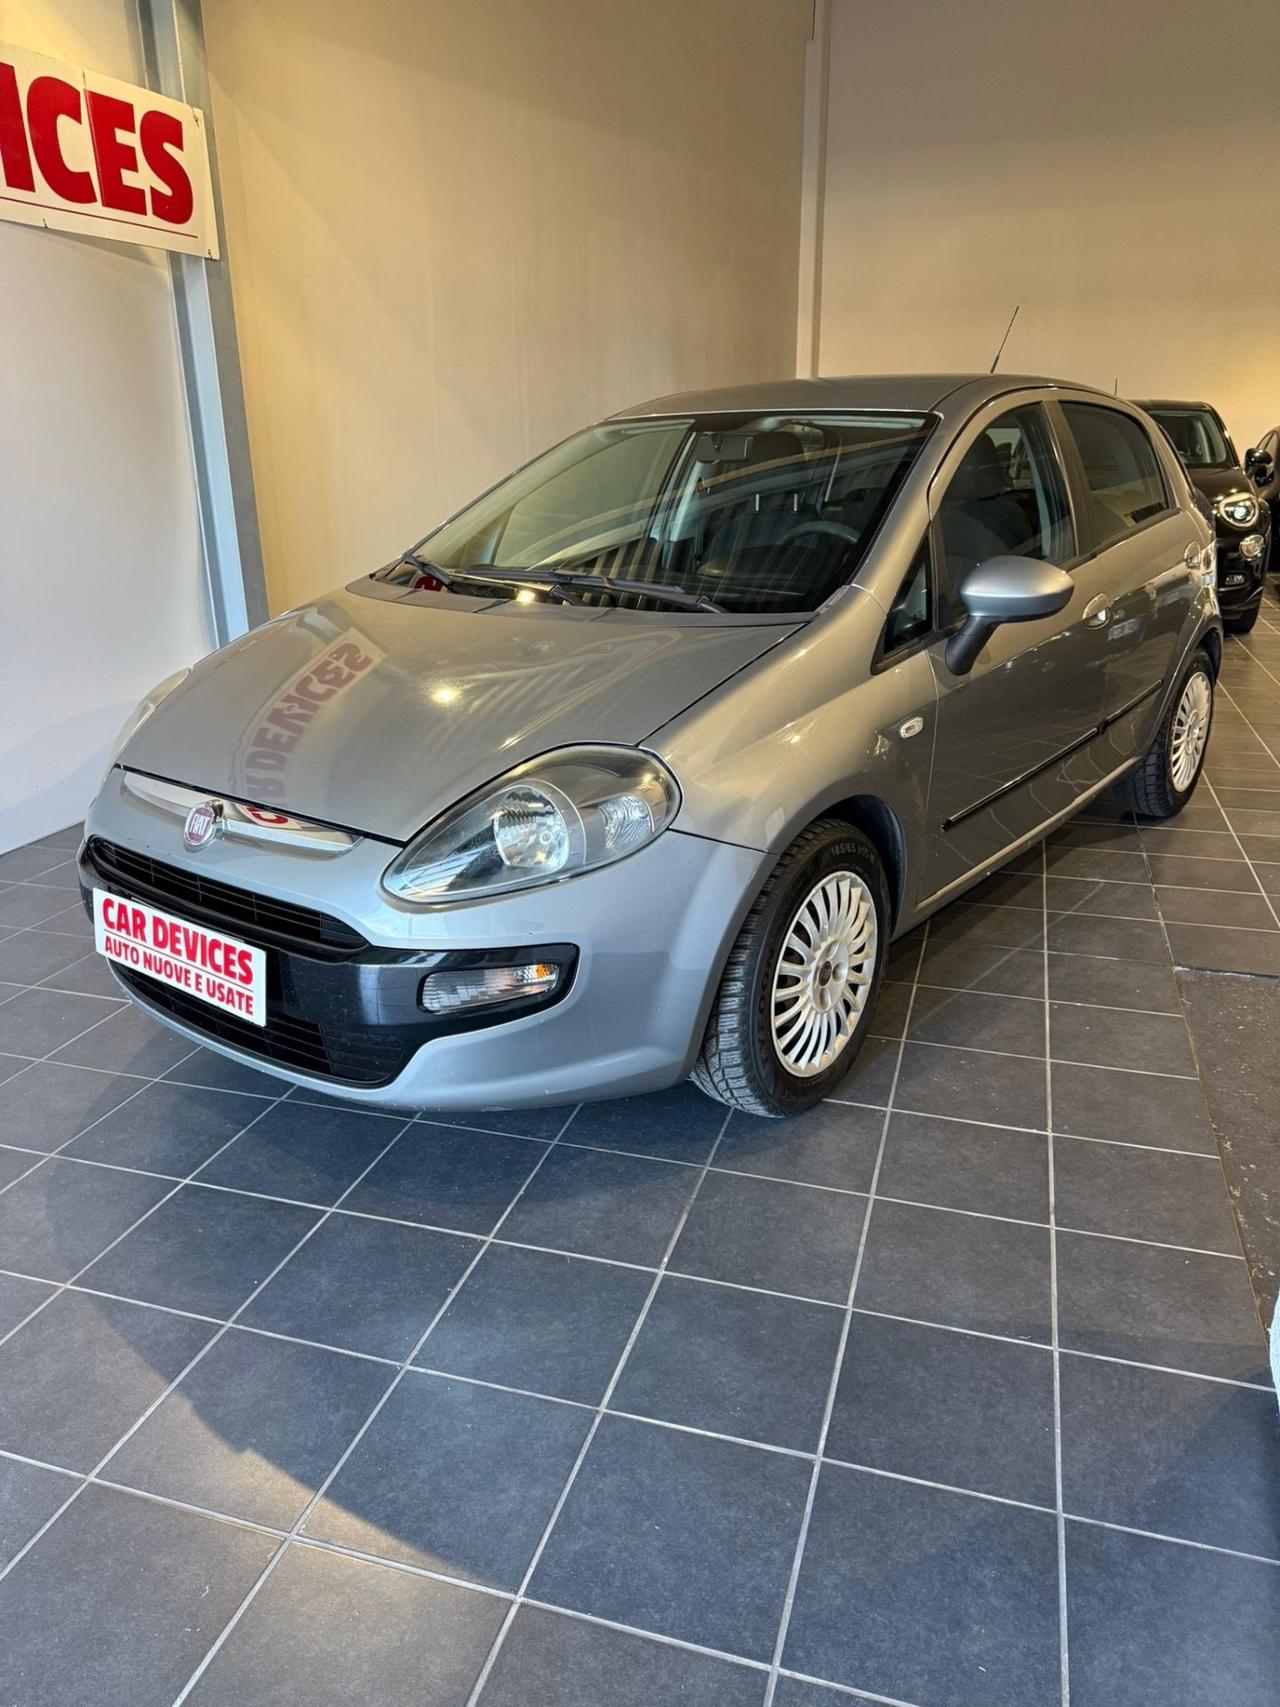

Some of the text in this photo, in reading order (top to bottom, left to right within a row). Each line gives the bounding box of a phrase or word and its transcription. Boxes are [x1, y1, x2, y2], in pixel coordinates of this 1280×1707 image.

[190, 813, 211, 836] FIAT
[103, 897, 254, 985] CAR DEVICES
[105, 935, 254, 1016] AUTO NUOVE E USATE
